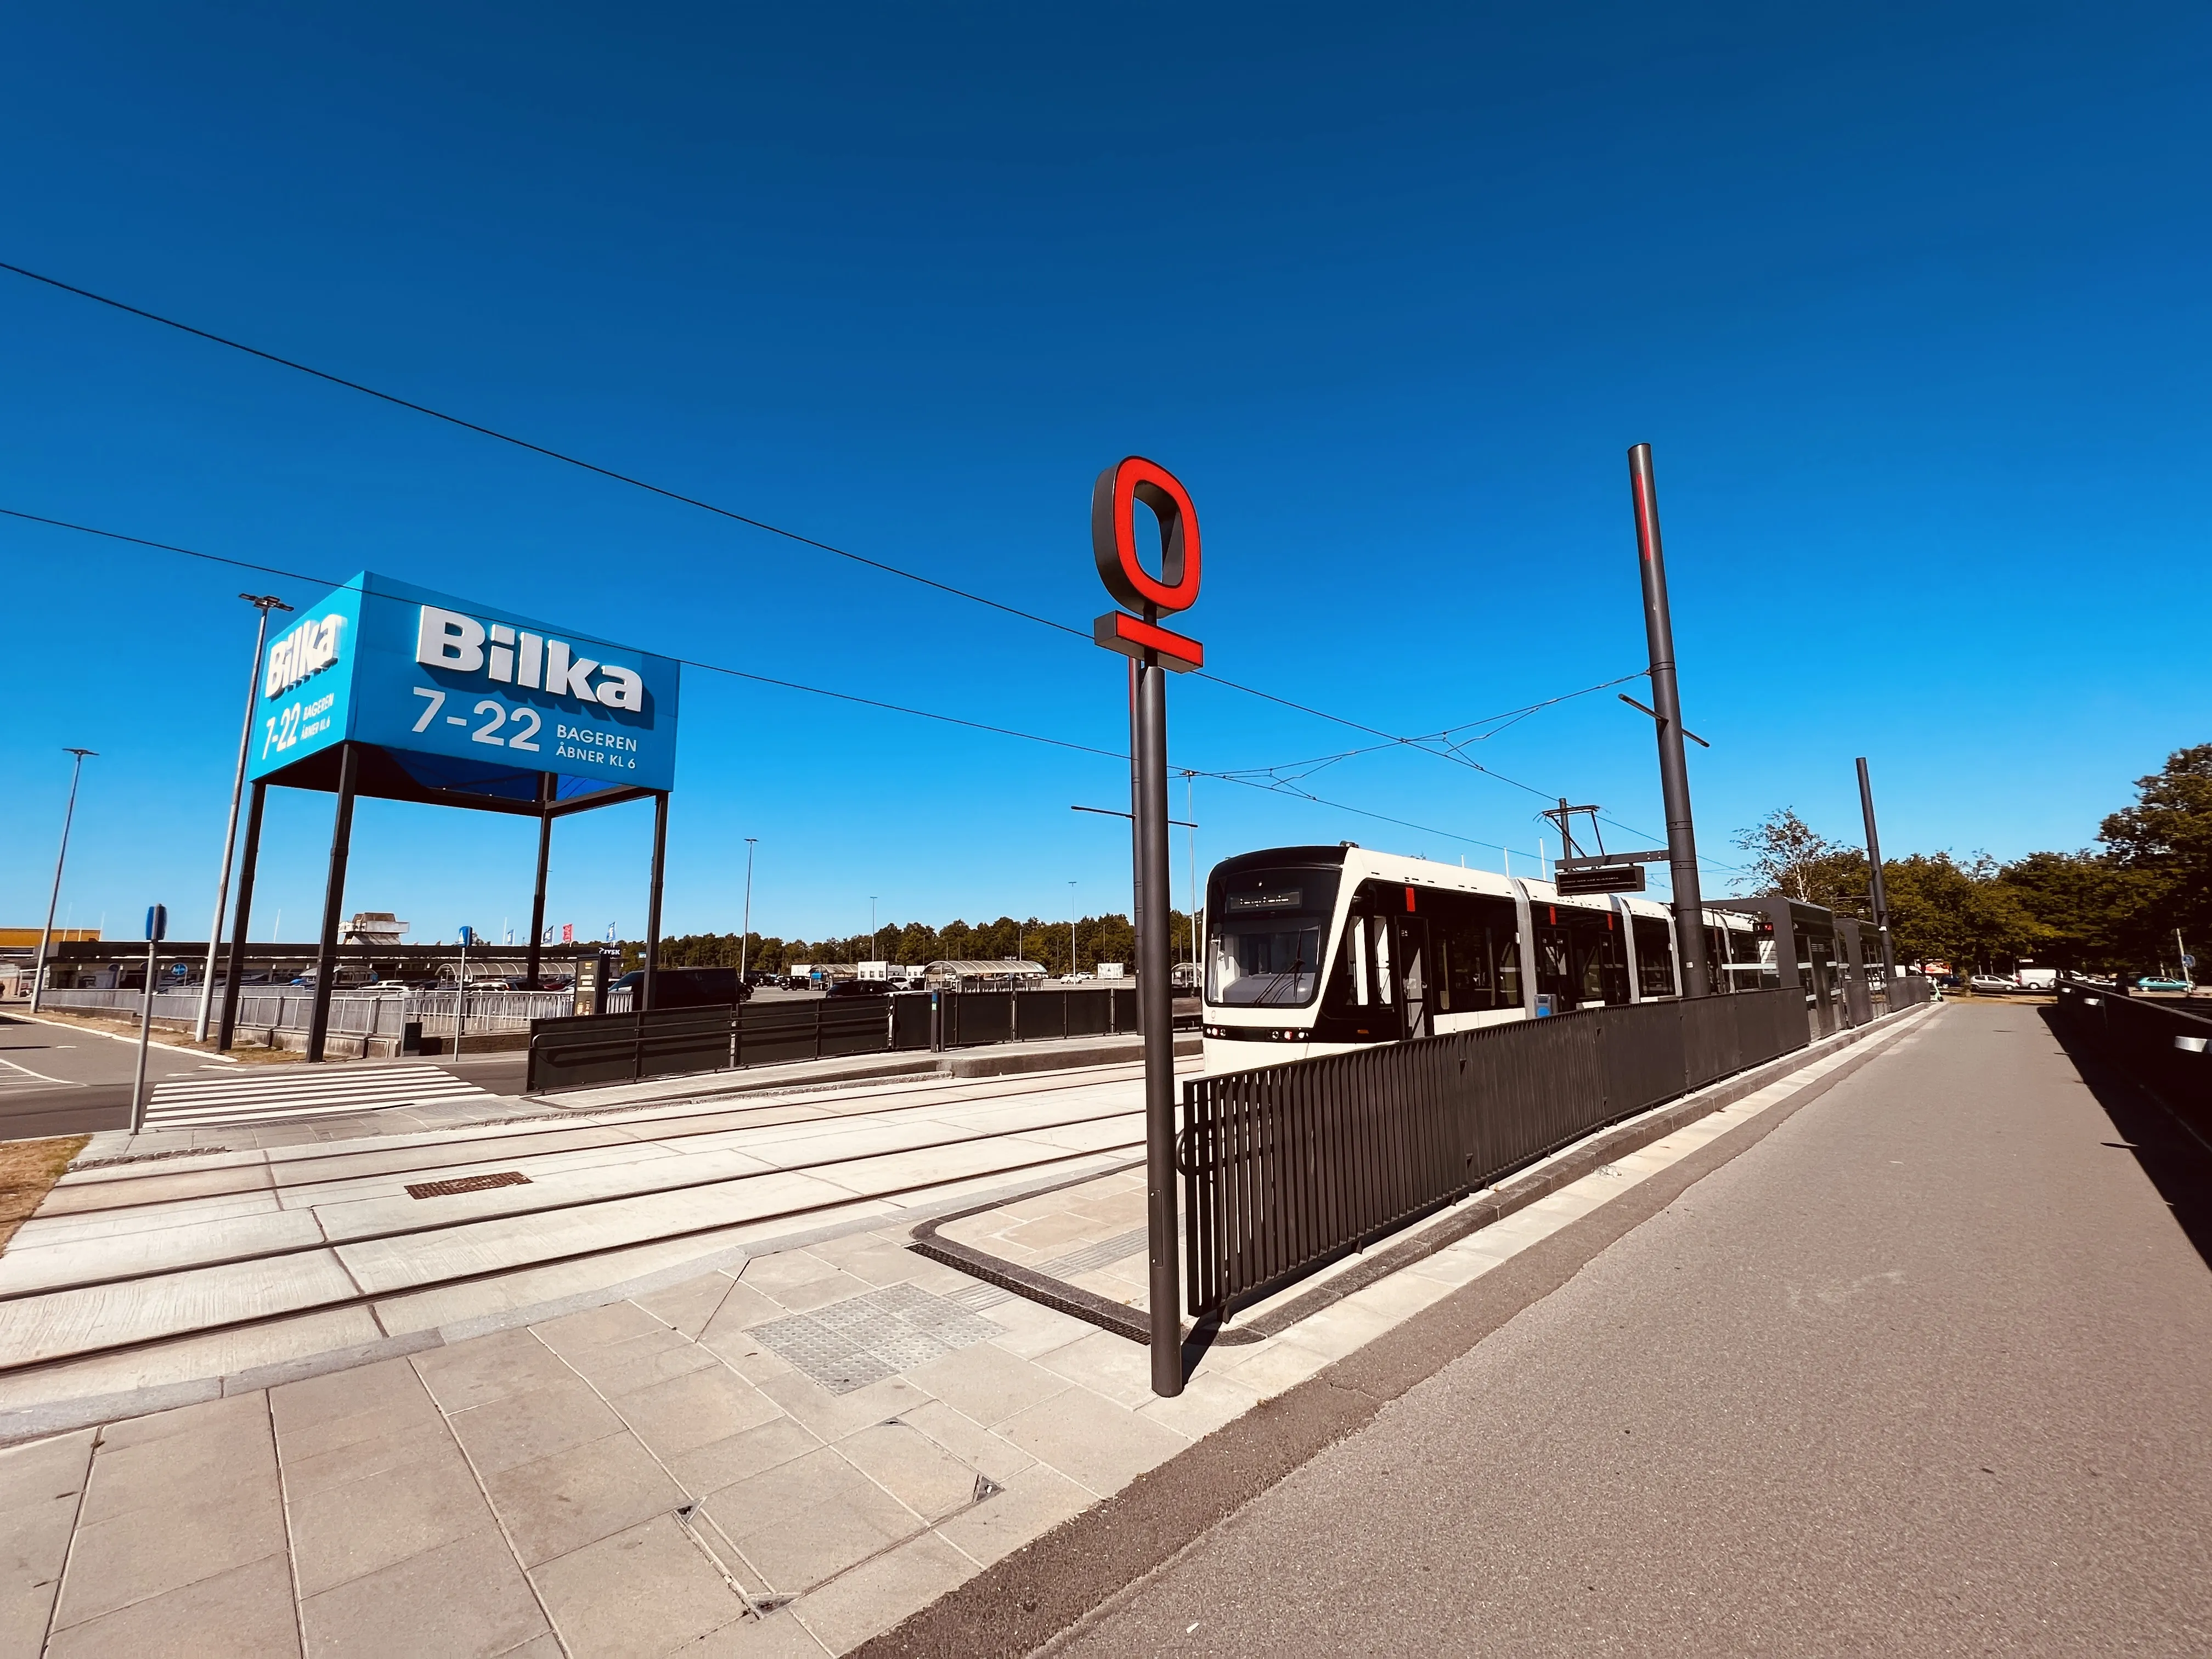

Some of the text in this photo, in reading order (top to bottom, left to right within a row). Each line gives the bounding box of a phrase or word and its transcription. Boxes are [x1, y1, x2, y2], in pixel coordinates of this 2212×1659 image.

[264, 614, 342, 698] Bilka
[415, 605, 643, 712] Bilka
[262, 702, 301, 760] 7-22
[303, 692, 334, 721] BAGEREN
[411, 686, 542, 752] 7-22
[555, 741, 636, 769] ÅBNER KL 6
[556, 724, 637, 752] BAGEREN
